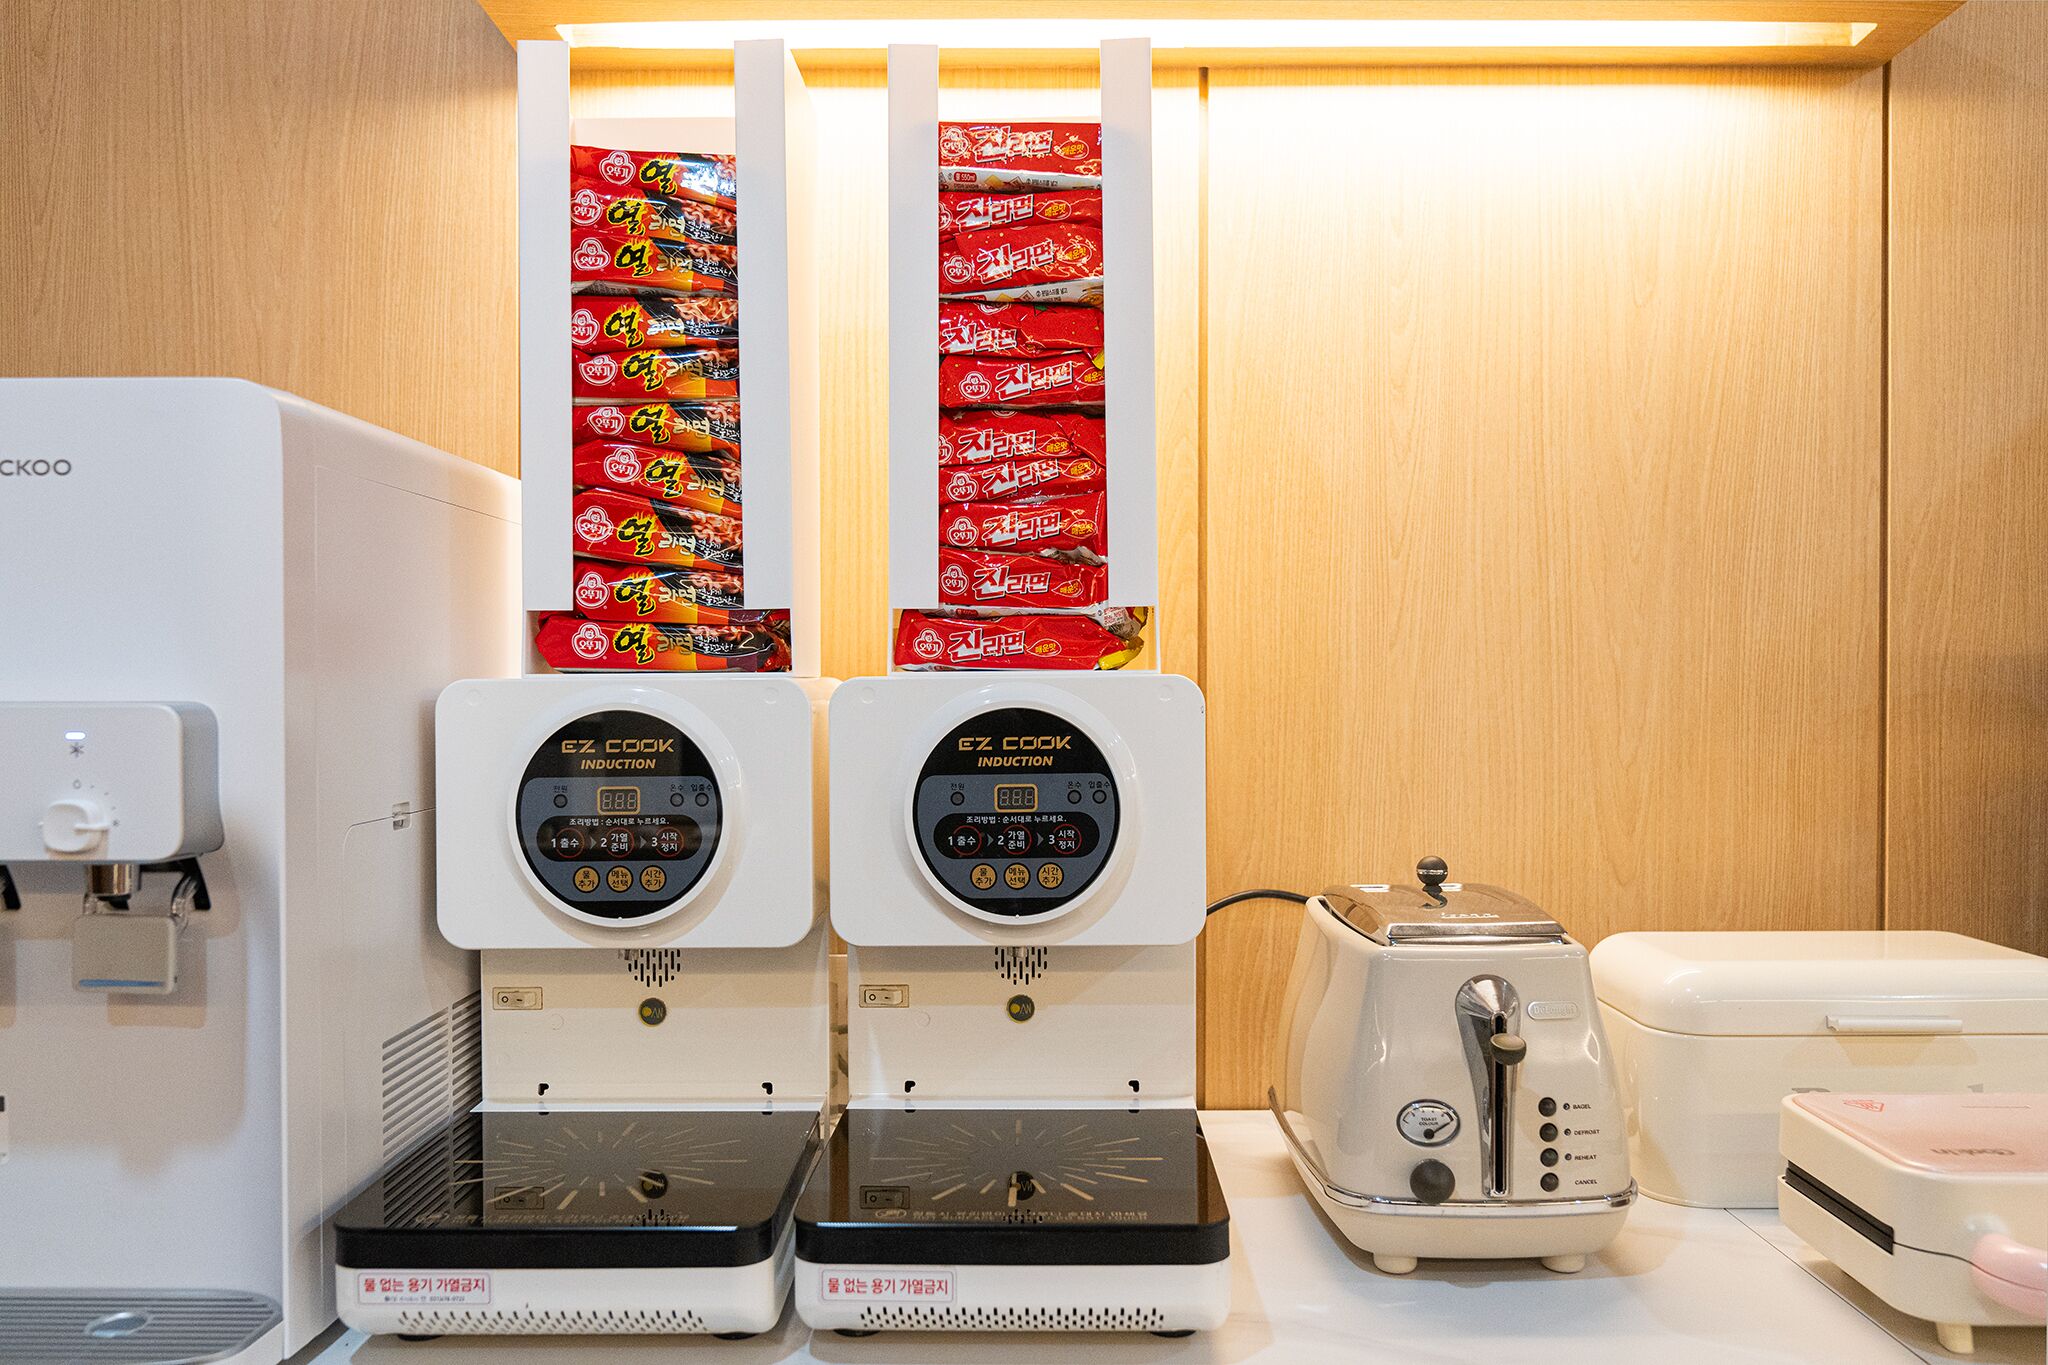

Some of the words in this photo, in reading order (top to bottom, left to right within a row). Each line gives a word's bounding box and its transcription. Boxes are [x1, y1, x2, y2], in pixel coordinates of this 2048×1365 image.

[956, 194, 1033, 232] 진라면
[607, 200, 686, 237] 열라면
[615, 243, 693, 278] 열라면
[977, 239, 1055, 284] 진라면
[604, 309, 685, 348] 열라면
[586, 366, 611, 377] 오뚜기
[622, 353, 703, 391] 열라면
[995, 361, 1073, 401] 진라면
[630, 407, 709, 444] 열라면
[957, 428, 1036, 464] 진라면
[645, 459, 726, 499] 열라면
[982, 458, 1060, 500] 진라면
[953, 486, 973, 496] 오뚜기
[981, 511, 1060, 546] 진라면
[617, 518, 696, 556] 열라면
[953, 531, 973, 541] 오뚜기
[945, 579, 964, 589] 오뚜기
[972, 566, 1051, 600] 진라면
[580, 590, 603, 600] 오뚜기
[614, 577, 697, 616] 열라면
[578, 640, 602, 651] 오뚜기
[613, 626, 694, 665] 열라면
[919, 643, 939, 652] 오뚜기
[948, 628, 1025, 663] 진라면
[1035, 643, 1057, 654] 매운맛
[562, 740, 595, 753] EZ
[606, 739, 674, 752] COOK
[959, 737, 992, 750] EZ
[1003, 736, 1071, 750] COOK
[581, 759, 656, 769] INDUCTION
[978, 756, 1053, 767] INDUCTION
[569, 818, 599, 826] 조리방법
[605, 818, 635, 826] 순서대로
[966, 816, 996, 824] 조리방법
[1002, 815, 1032, 823] 순서대로
[1034, 815, 1067, 823] 누르세요.
[611, 833, 628, 843] 가열
[661, 832, 678, 842] 시작
[1008, 830, 1025, 840] 가열
[1058, 829, 1075, 839] 시작
[551, 839, 556, 848] 1
[560, 838, 579, 848] 출수
[601, 838, 607, 848] 2
[652, 838, 658, 847] 3
[948, 836, 953, 845] 1
[957, 836, 976, 846] 출수
[997, 836, 1004, 845] 2
[1008, 840, 1025, 849] 준비
[1049, 835, 1055, 844] 3
[1058, 840, 1075, 849] 정지
[611, 843, 628, 852] 준비
[661, 843, 678, 852] 정지
[611, 870, 628, 879] 메뉴
[645, 870, 662, 879] 시간
[1008, 868, 1025, 877] 메뉴
[1042, 867, 1059, 876] 시간
[578, 880, 595, 888] 추가
[612, 879, 628, 888] 선택
[645, 879, 662, 888] 추가
[975, 877, 992, 885] 추가
[1009, 876, 1026, 885] 선택
[1042, 876, 1060, 885] 추가
[380, 1278, 404, 1293] 없는
[408, 1278, 432, 1293] 용기
[436, 1278, 485, 1293] 가열금지
[828, 1278, 840, 1294] 물
[843, 1278, 868, 1294] 없는
[871, 1278, 896, 1294] 용기
[900, 1278, 948, 1295] 가열금지
